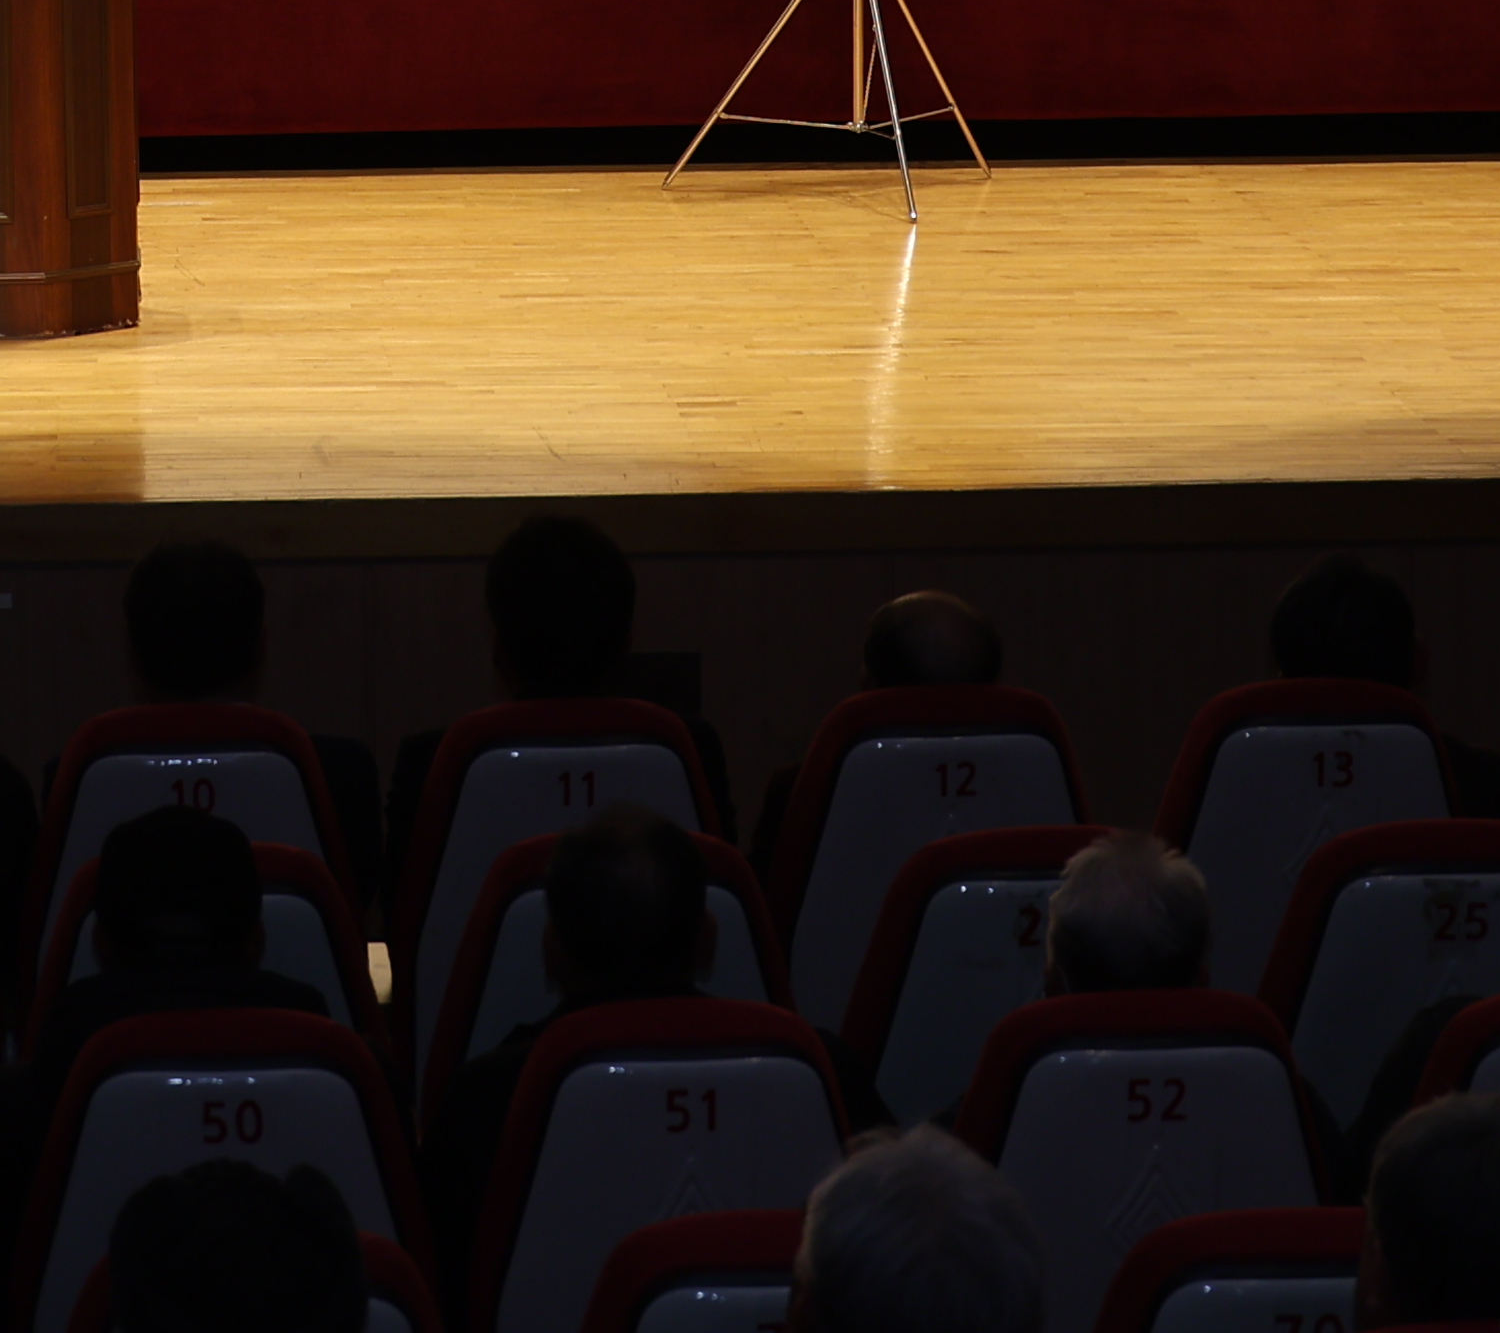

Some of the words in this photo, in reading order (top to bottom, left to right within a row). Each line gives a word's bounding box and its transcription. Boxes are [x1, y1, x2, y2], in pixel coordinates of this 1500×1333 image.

[936, 761, 976, 797] 12
[1313, 751, 1354, 788] 13
[171, 778, 216, 814] 10
[558, 771, 594, 807] 11
[1434, 902, 1488, 942] 25
[667, 1089, 716, 1133] 51
[1128, 1078, 1186, 1123] 52
[203, 1100, 263, 1144] 50
